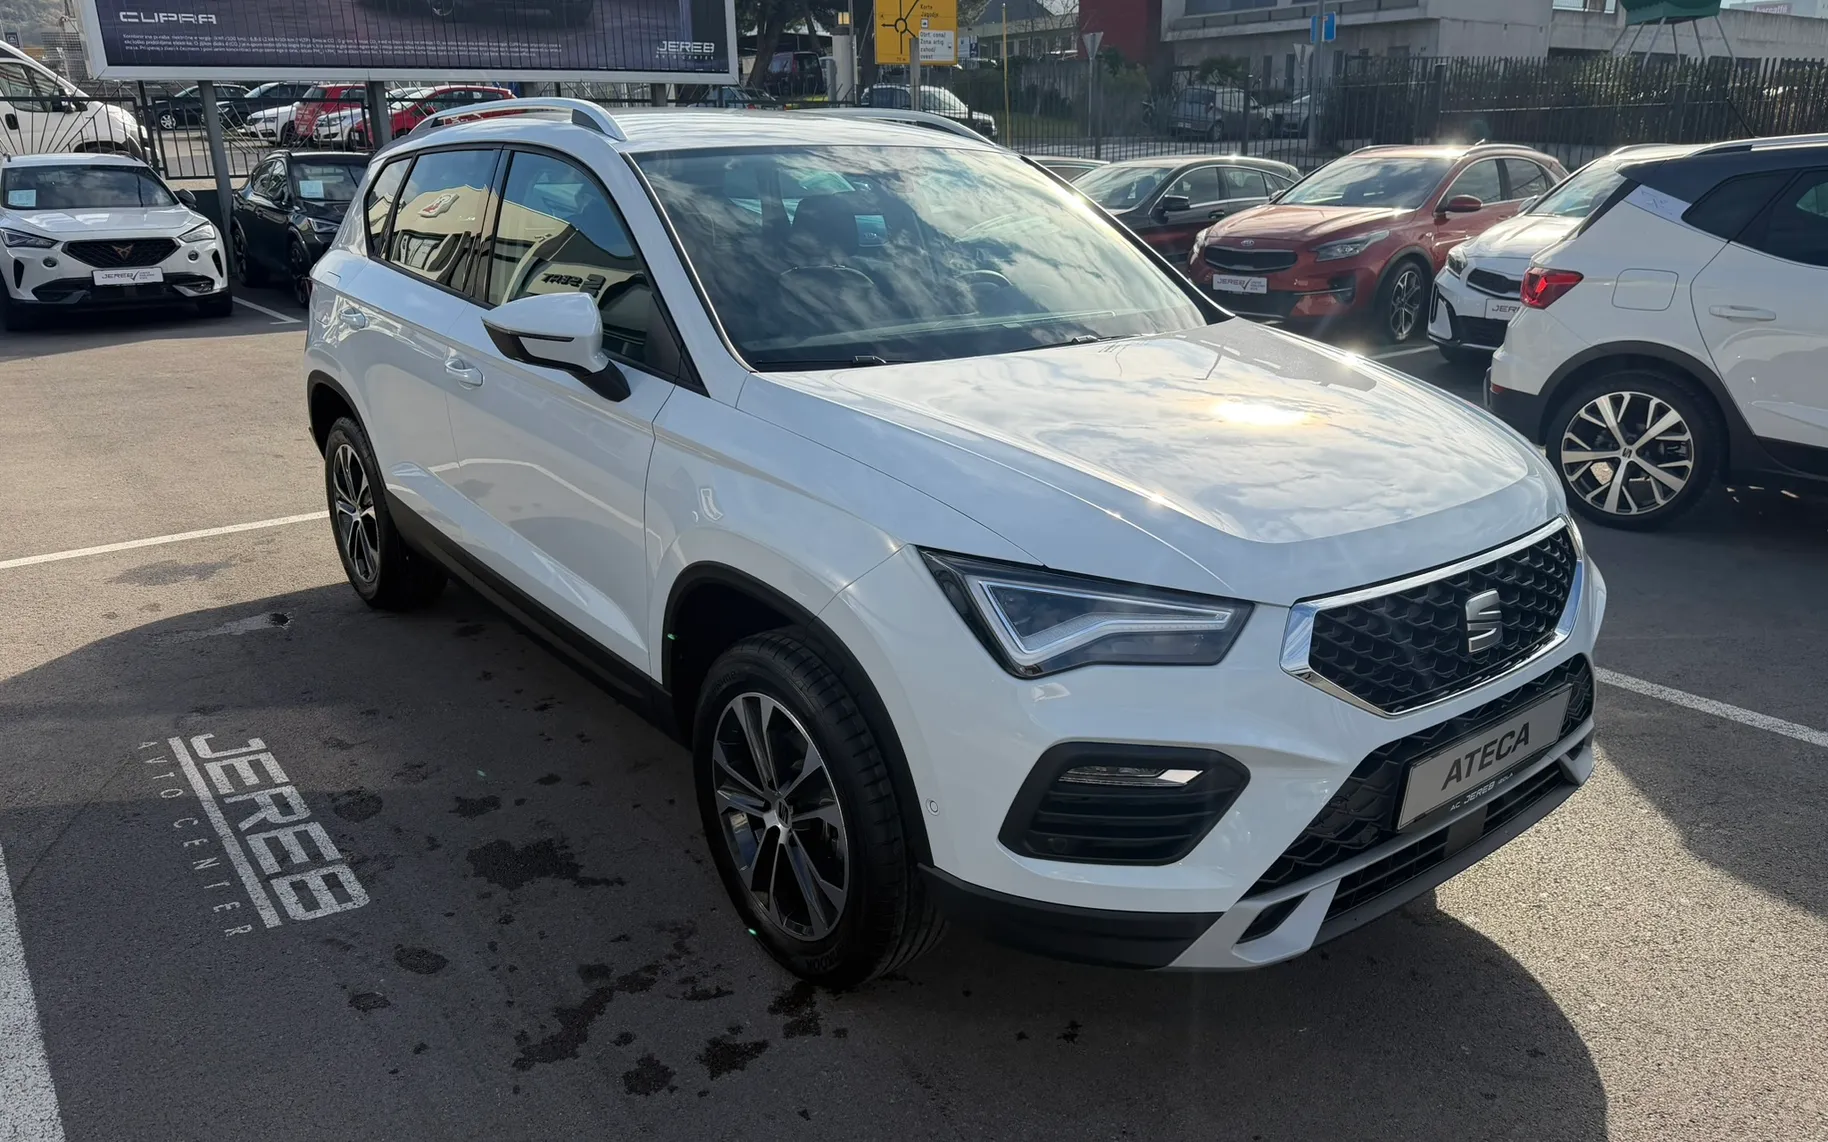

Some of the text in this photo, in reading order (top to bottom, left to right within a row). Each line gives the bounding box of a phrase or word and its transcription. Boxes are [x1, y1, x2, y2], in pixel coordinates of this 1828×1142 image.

[119, 11, 217, 24] CUPRA
[656, 40, 715, 53] JEREB
[1441, 722, 1530, 791] ATECA
[1449, 801, 1461, 812] AC
[1463, 780, 1496, 805] JEREB
[137, 741, 253, 937] AVTO CENTER
[190, 733, 370, 921] JEREB
